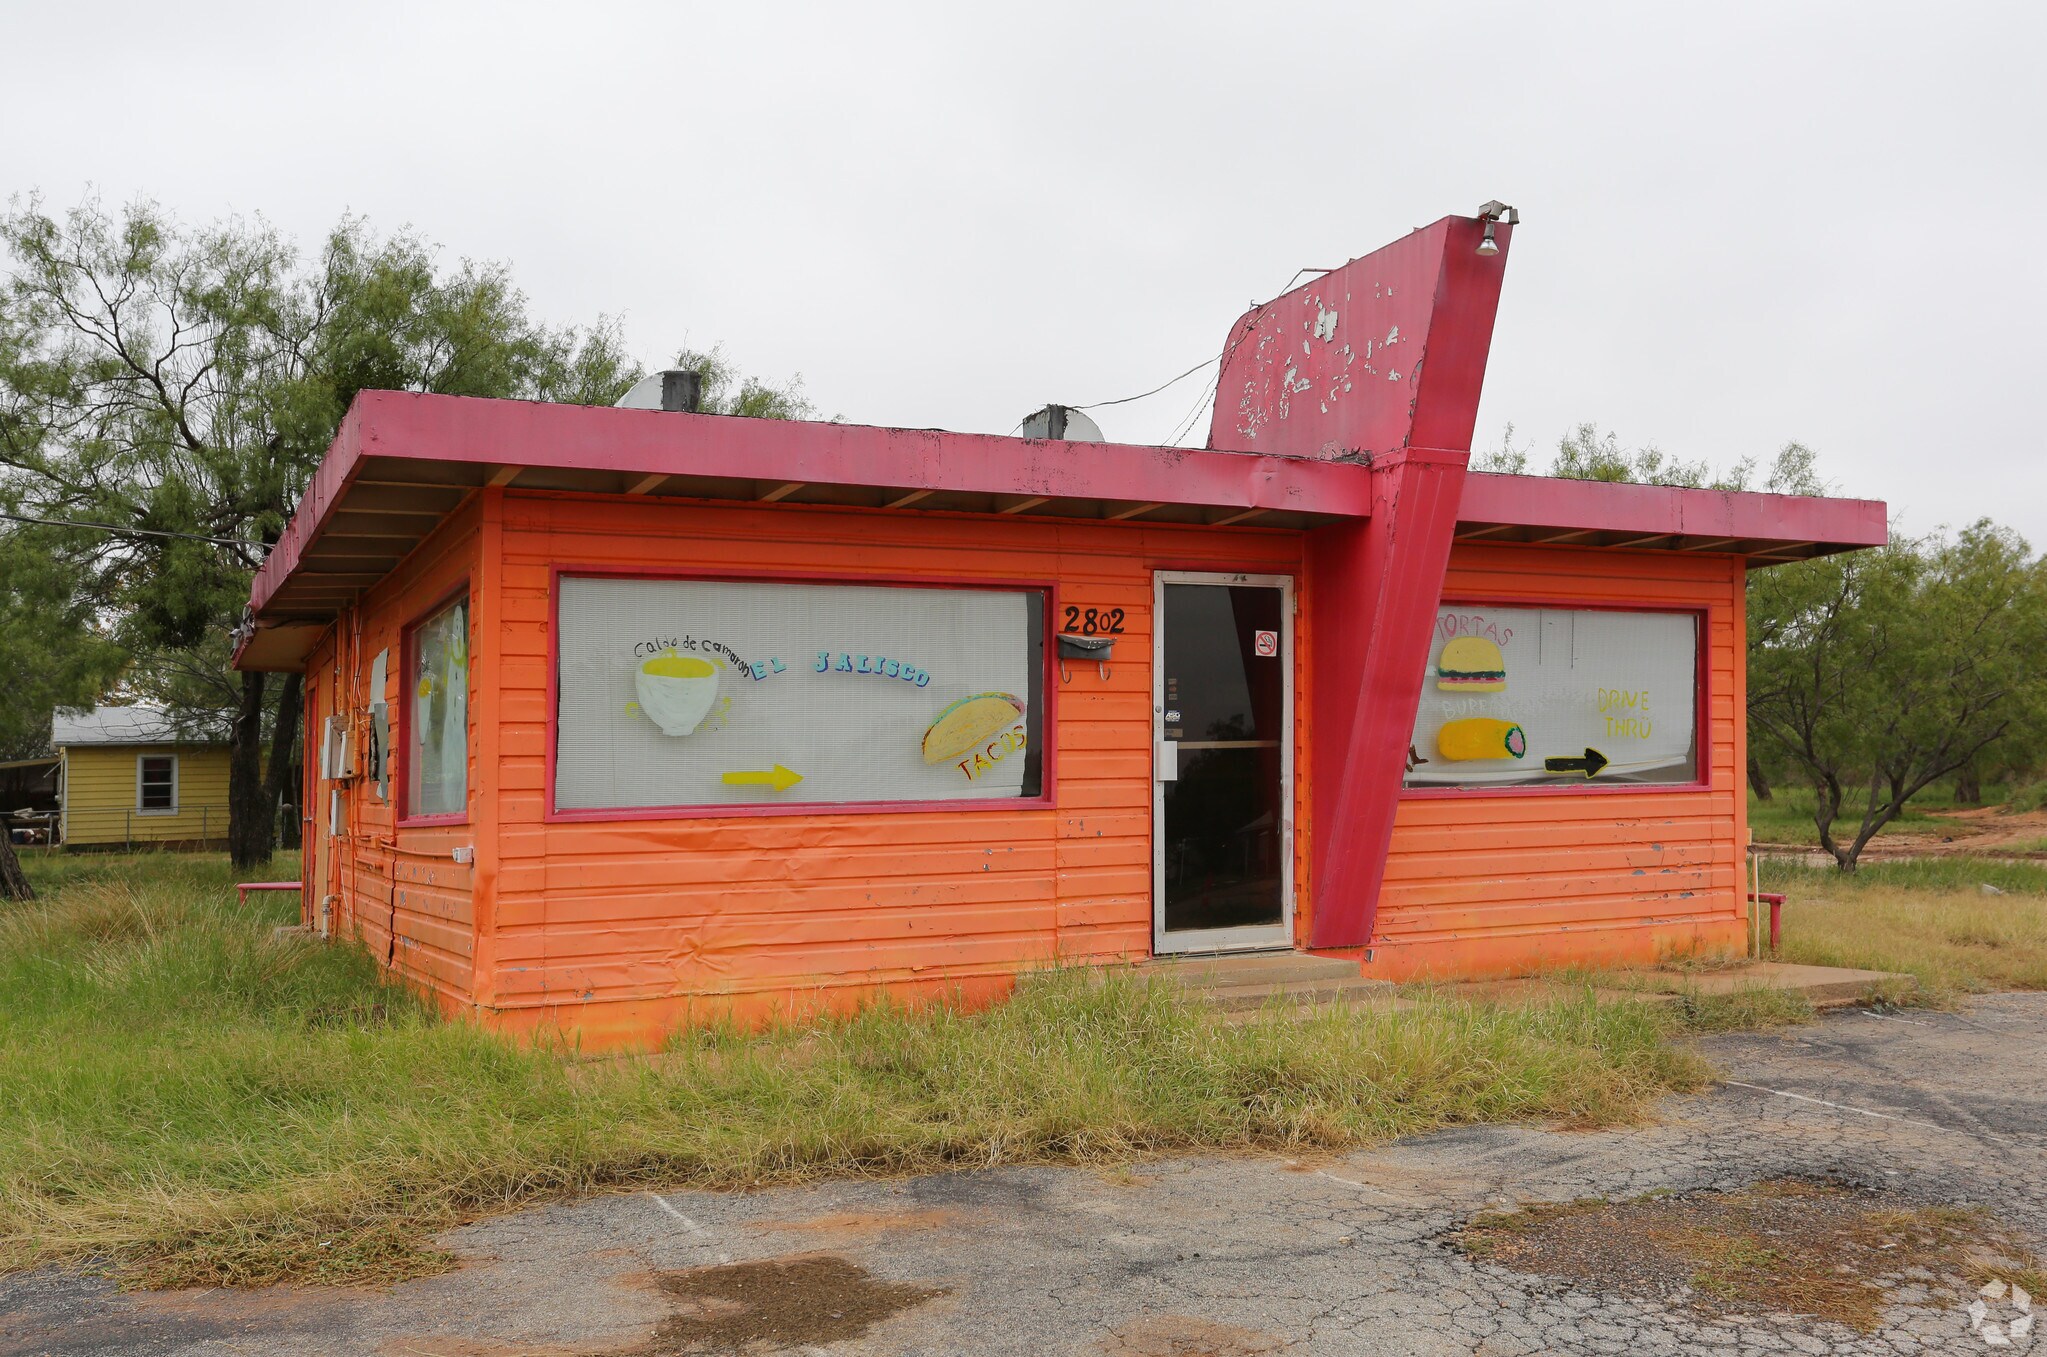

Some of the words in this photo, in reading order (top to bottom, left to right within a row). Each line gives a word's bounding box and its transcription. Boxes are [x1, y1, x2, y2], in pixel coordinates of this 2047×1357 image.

[1064, 605, 1125, 636] 2802
[1436, 613, 1514, 647] TORTAS
[682, 634, 697, 651] de
[750, 656, 787, 681] EL
[814, 650, 930, 688] JALISCO
[1598, 687, 1649, 712] DRIVE
[956, 724, 1028, 781] TACOS
